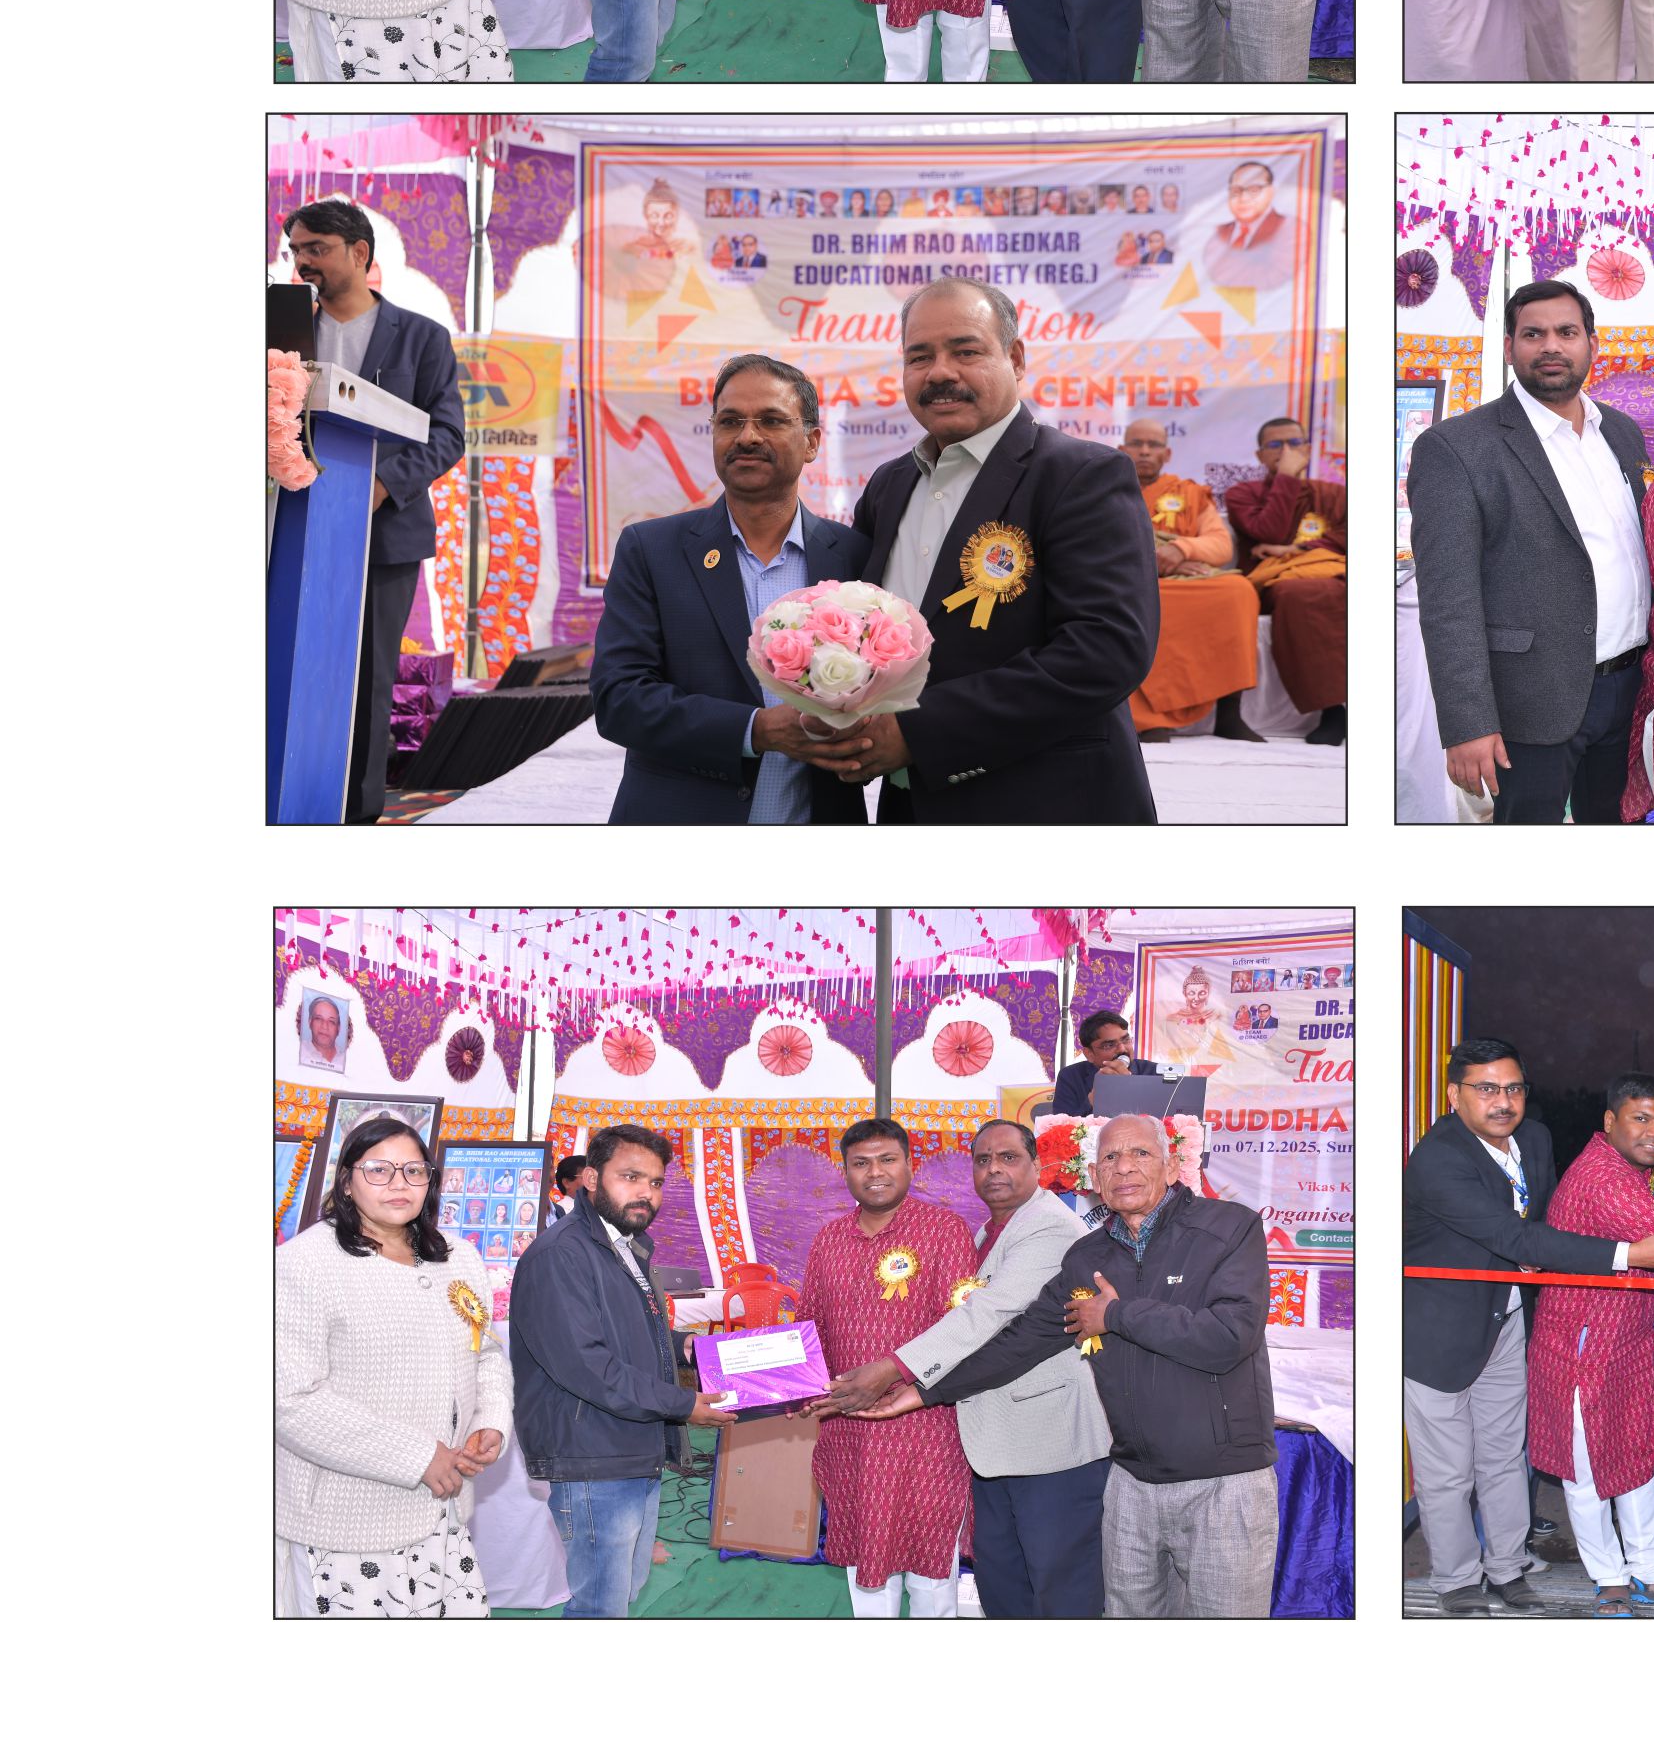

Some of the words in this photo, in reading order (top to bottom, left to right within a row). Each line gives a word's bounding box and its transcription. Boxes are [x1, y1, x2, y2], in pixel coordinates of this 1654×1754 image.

[811, 232, 845, 254] DR.
[852, 232, 907, 254] BHIM
[913, 231, 956, 253] RAO
[961, 231, 1081, 253] AMBEDKAR
[794, 263, 934, 286] EDUCATIONAL
[1035, 262, 1099, 286] (REG.)
[1033, 375, 1201, 408] CENTER
[838, 419, 909, 439] Sunday
[1315, 1000, 1344, 1017] DR.
[1205, 1106, 1349, 1134] BUDDHA
[1212, 1143, 1230, 1154] on
[1235, 1140, 1321, 1155] 07.12.2025,
[1297, 1180, 1336, 1192] Vikas
